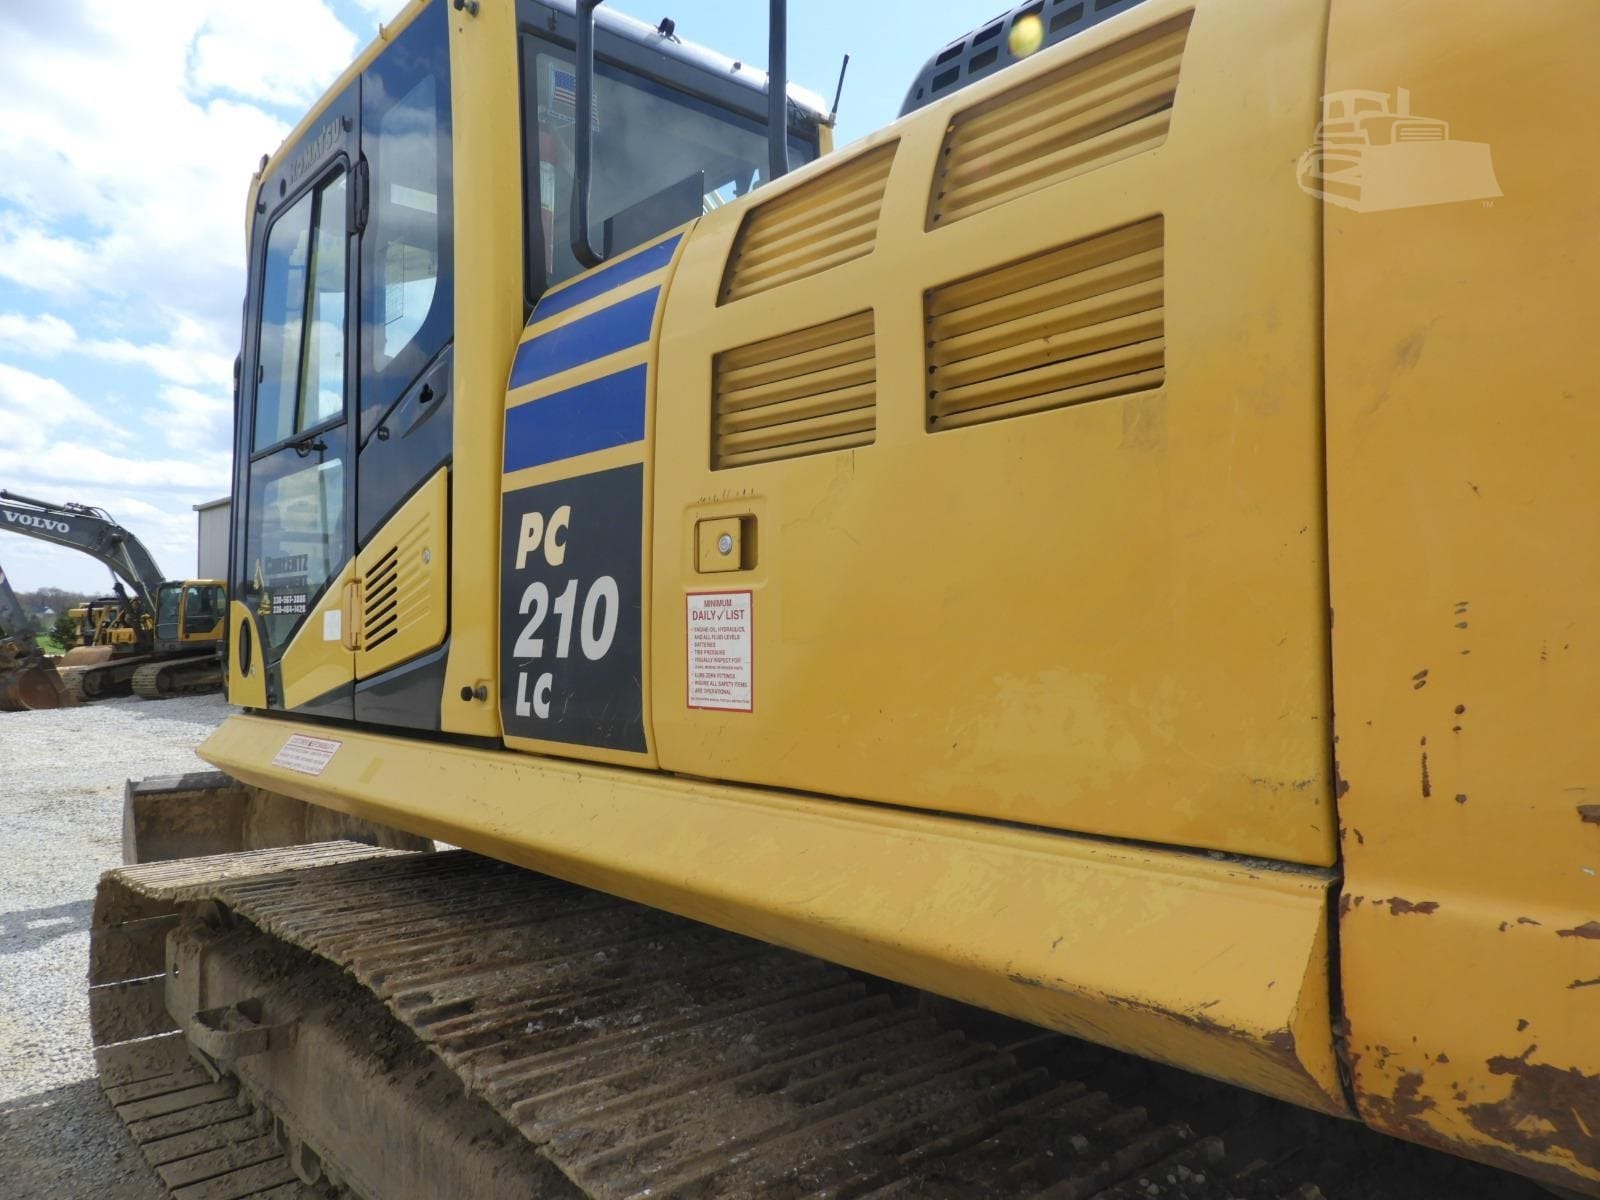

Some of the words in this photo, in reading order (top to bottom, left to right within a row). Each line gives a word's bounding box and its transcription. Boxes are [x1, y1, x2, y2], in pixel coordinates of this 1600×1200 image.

[287, 117, 340, 186] KOMATSU
[2, 510, 70, 533] VOLVO
[515, 505, 571, 569] PC
[513, 575, 619, 661] 210
[692, 610, 716, 620] DAILY
[726, 609, 745, 620] LIST
[704, 599, 732, 607] MINIMUM
[516, 672, 553, 719] LC
